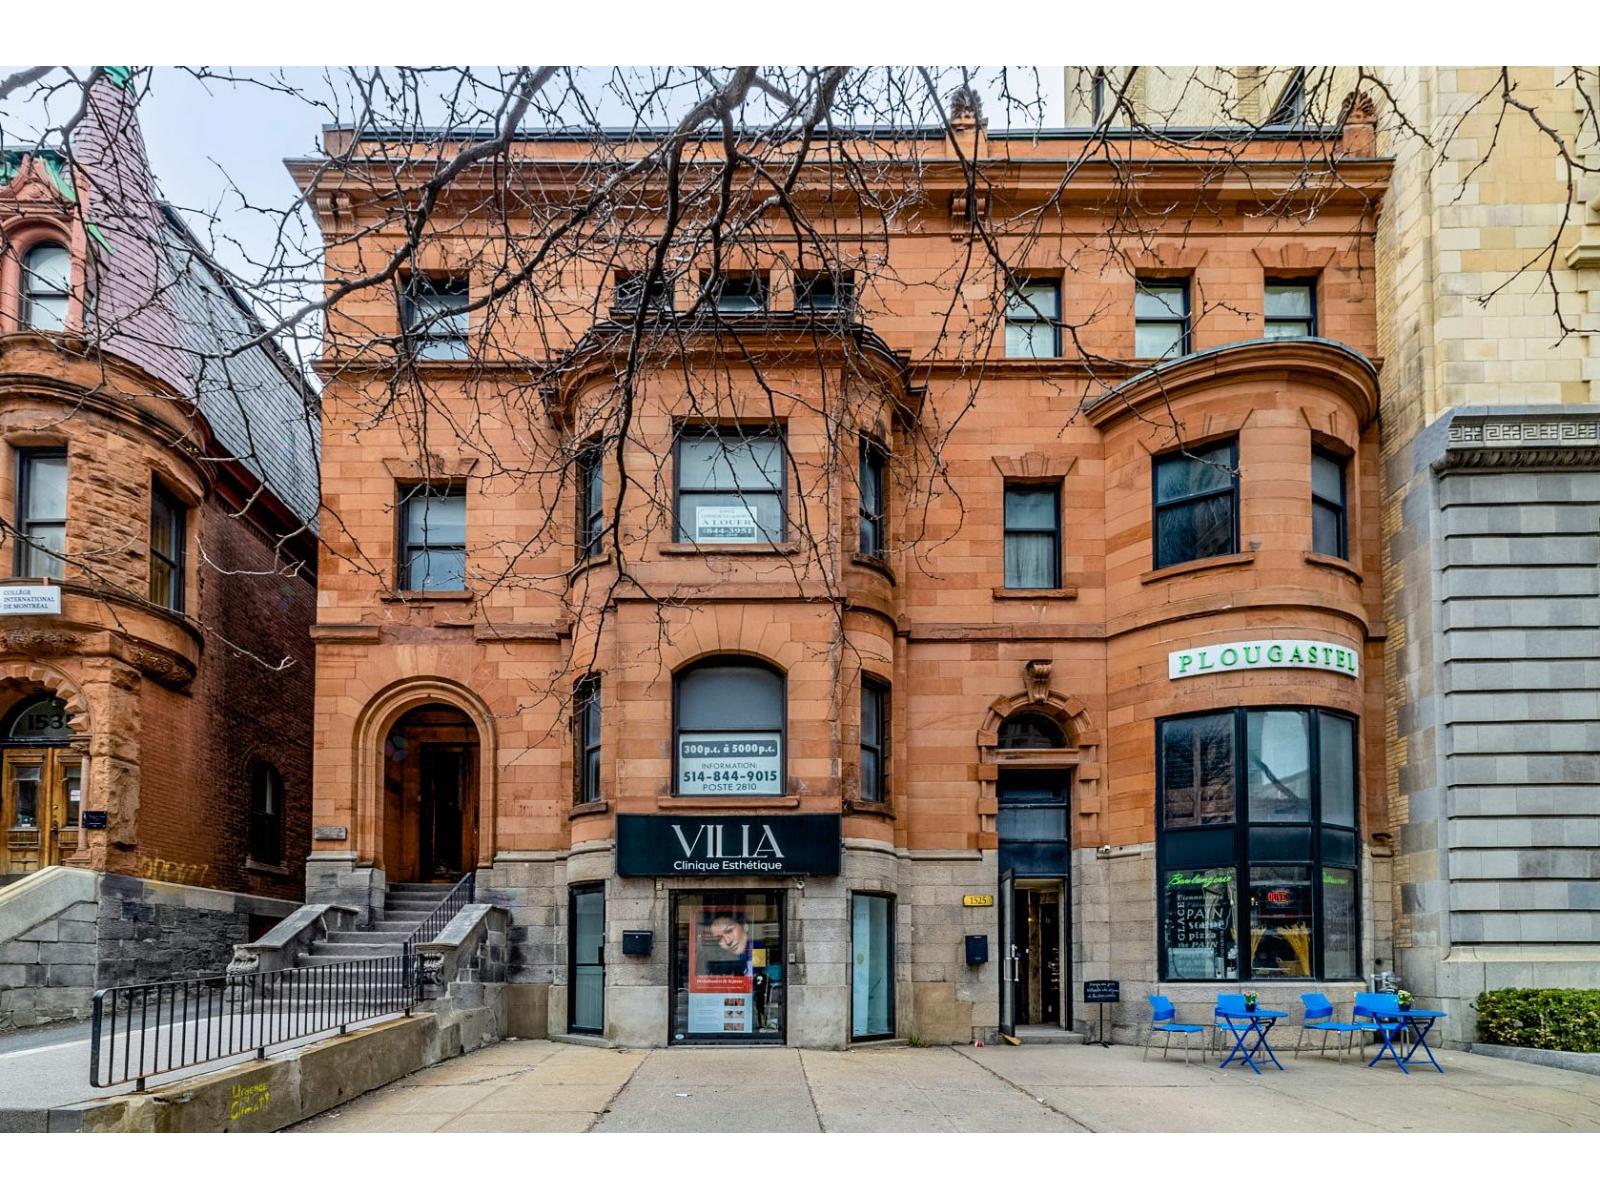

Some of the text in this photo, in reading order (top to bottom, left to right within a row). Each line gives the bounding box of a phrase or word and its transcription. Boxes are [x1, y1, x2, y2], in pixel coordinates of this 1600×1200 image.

[1178, 645, 1355, 673] PLOUGASTEL
[683, 770, 777, 782] 514-844-9015
[673, 860, 782, 871] Clinique Esthétique
[1187, 907, 1223, 920] PAIN
[1177, 901, 1185, 941] GLACE
[1189, 931, 1217, 941] pizza
